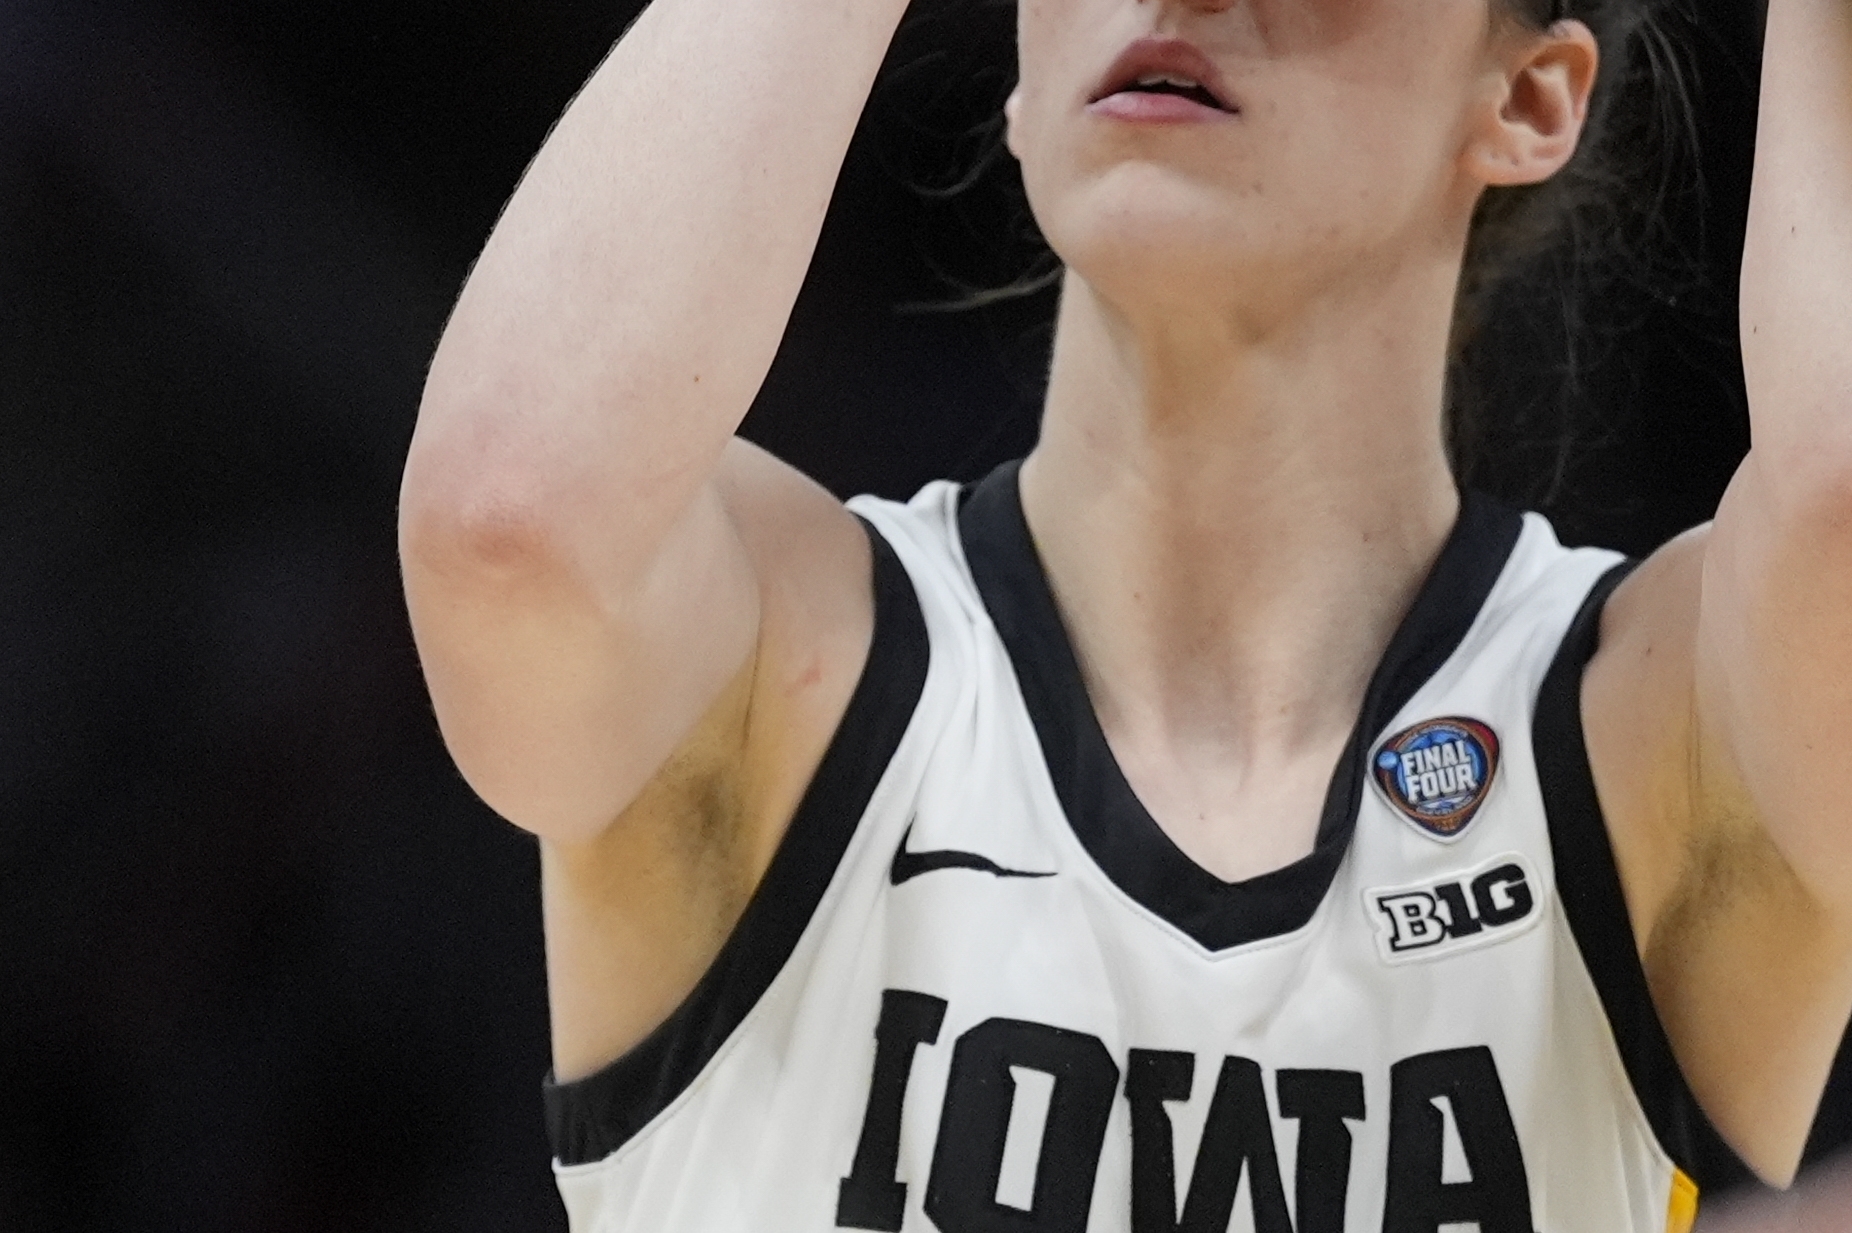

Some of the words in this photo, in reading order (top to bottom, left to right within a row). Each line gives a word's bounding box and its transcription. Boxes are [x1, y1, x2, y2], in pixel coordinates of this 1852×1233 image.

[1401, 740, 1471, 776] FINAL
[1406, 763, 1478, 804] FOUR
[835, 988, 1541, 1233] IOWA
